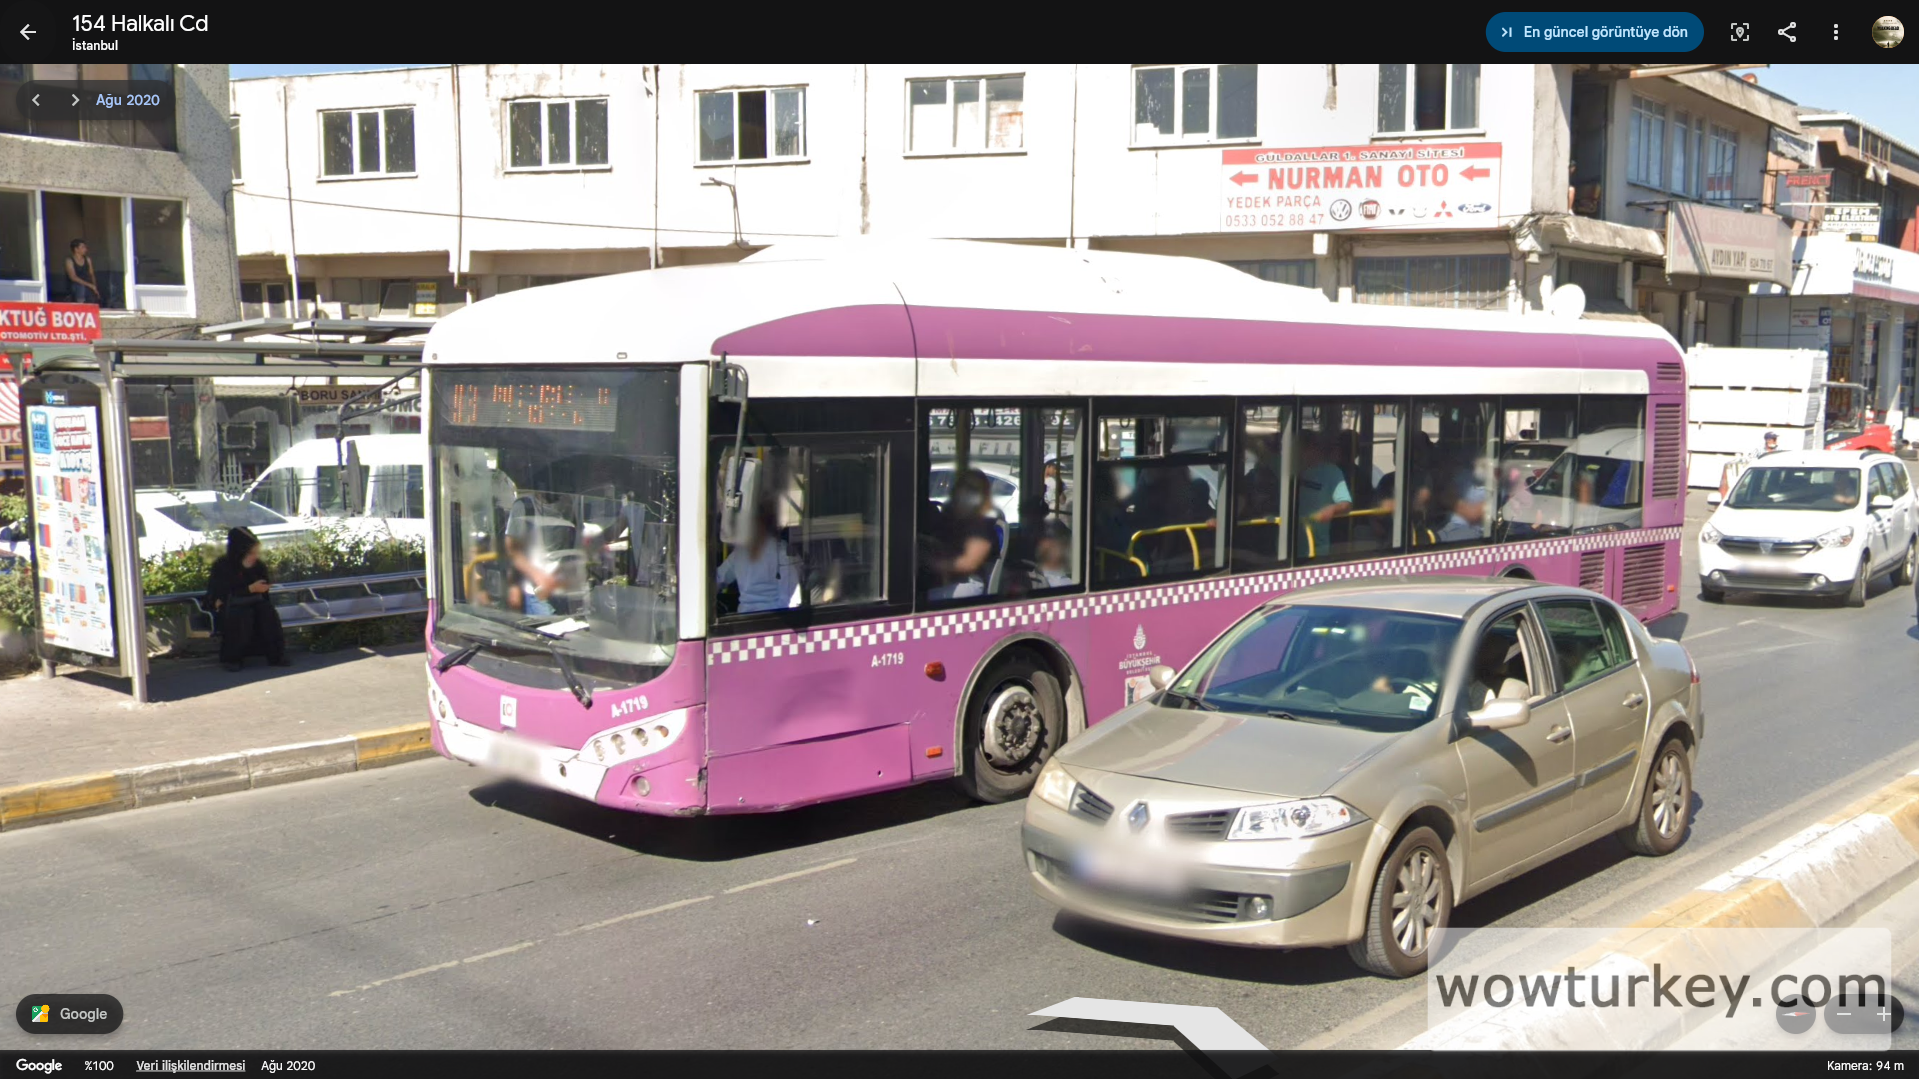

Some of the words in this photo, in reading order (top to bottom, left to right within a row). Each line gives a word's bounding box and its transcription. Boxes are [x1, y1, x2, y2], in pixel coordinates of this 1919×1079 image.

[1255, 151, 1340, 163] GÜLDALLAR
[1360, 148, 1414, 160] SANAYİ
[1417, 147, 1465, 159] SİTESİ
[1268, 165, 1382, 190] NURMAN
[1398, 164, 1449, 188] OTO
[1227, 195, 1271, 209] YEDEK
[1276, 195, 1321, 210] PARÇA
[1226, 214, 1256, 228] 0533
[1261, 213, 1284, 227] 052
[1289, 213, 1305, 226] 88
[1309, 213, 1325, 226] 47
[1712, 249, 1732, 267] AYDIN
[1733, 250, 1747, 267] YAPI
[52, 312, 96, 328] BOYA
[0, 331, 49, 340] OTOMOTİV
[301, 390, 338, 401] BORU
[871, 652, 904, 668] A-1719
[1119, 654, 1161, 670] BÜYÜKŞEHİR
[611, 695, 649, 719] A-1719
